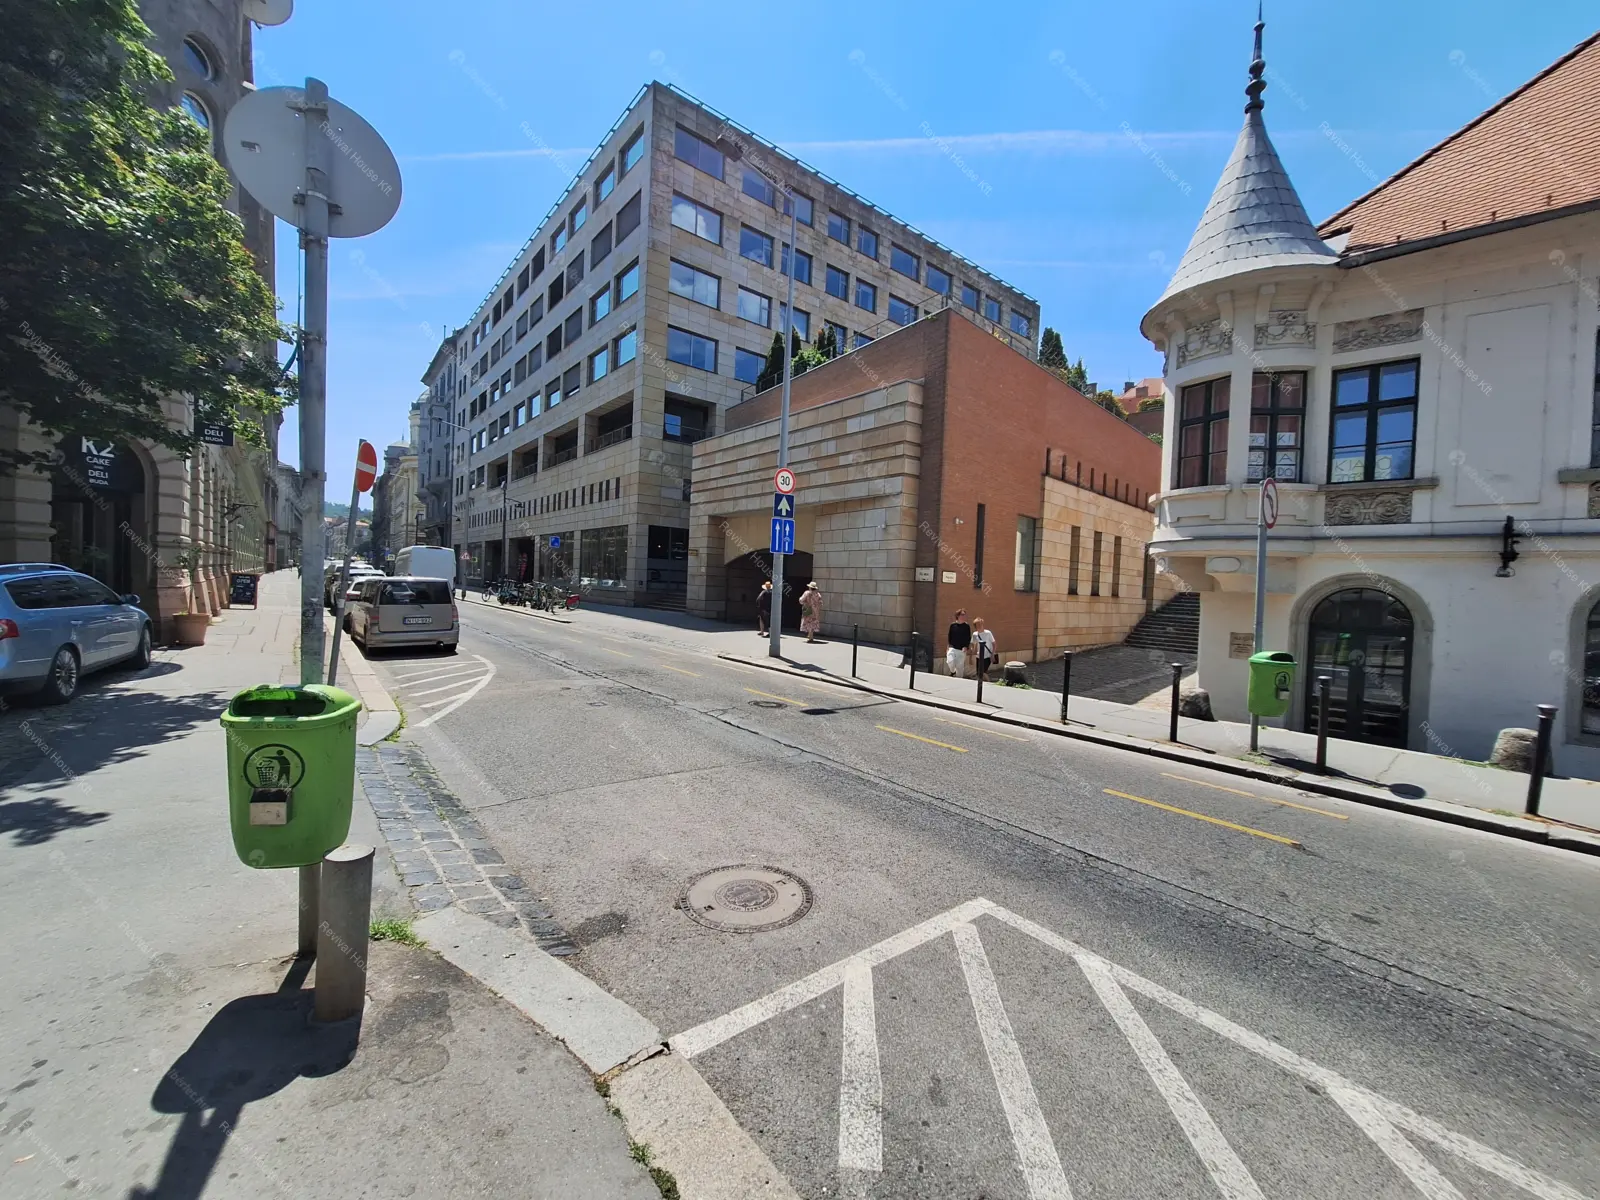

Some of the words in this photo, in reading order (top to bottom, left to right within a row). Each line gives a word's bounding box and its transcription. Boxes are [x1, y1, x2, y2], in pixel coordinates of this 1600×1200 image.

[86, 456, 112, 466] CAKE
[88, 470, 108, 478] DELI
[780, 476, 790, 486] 30
